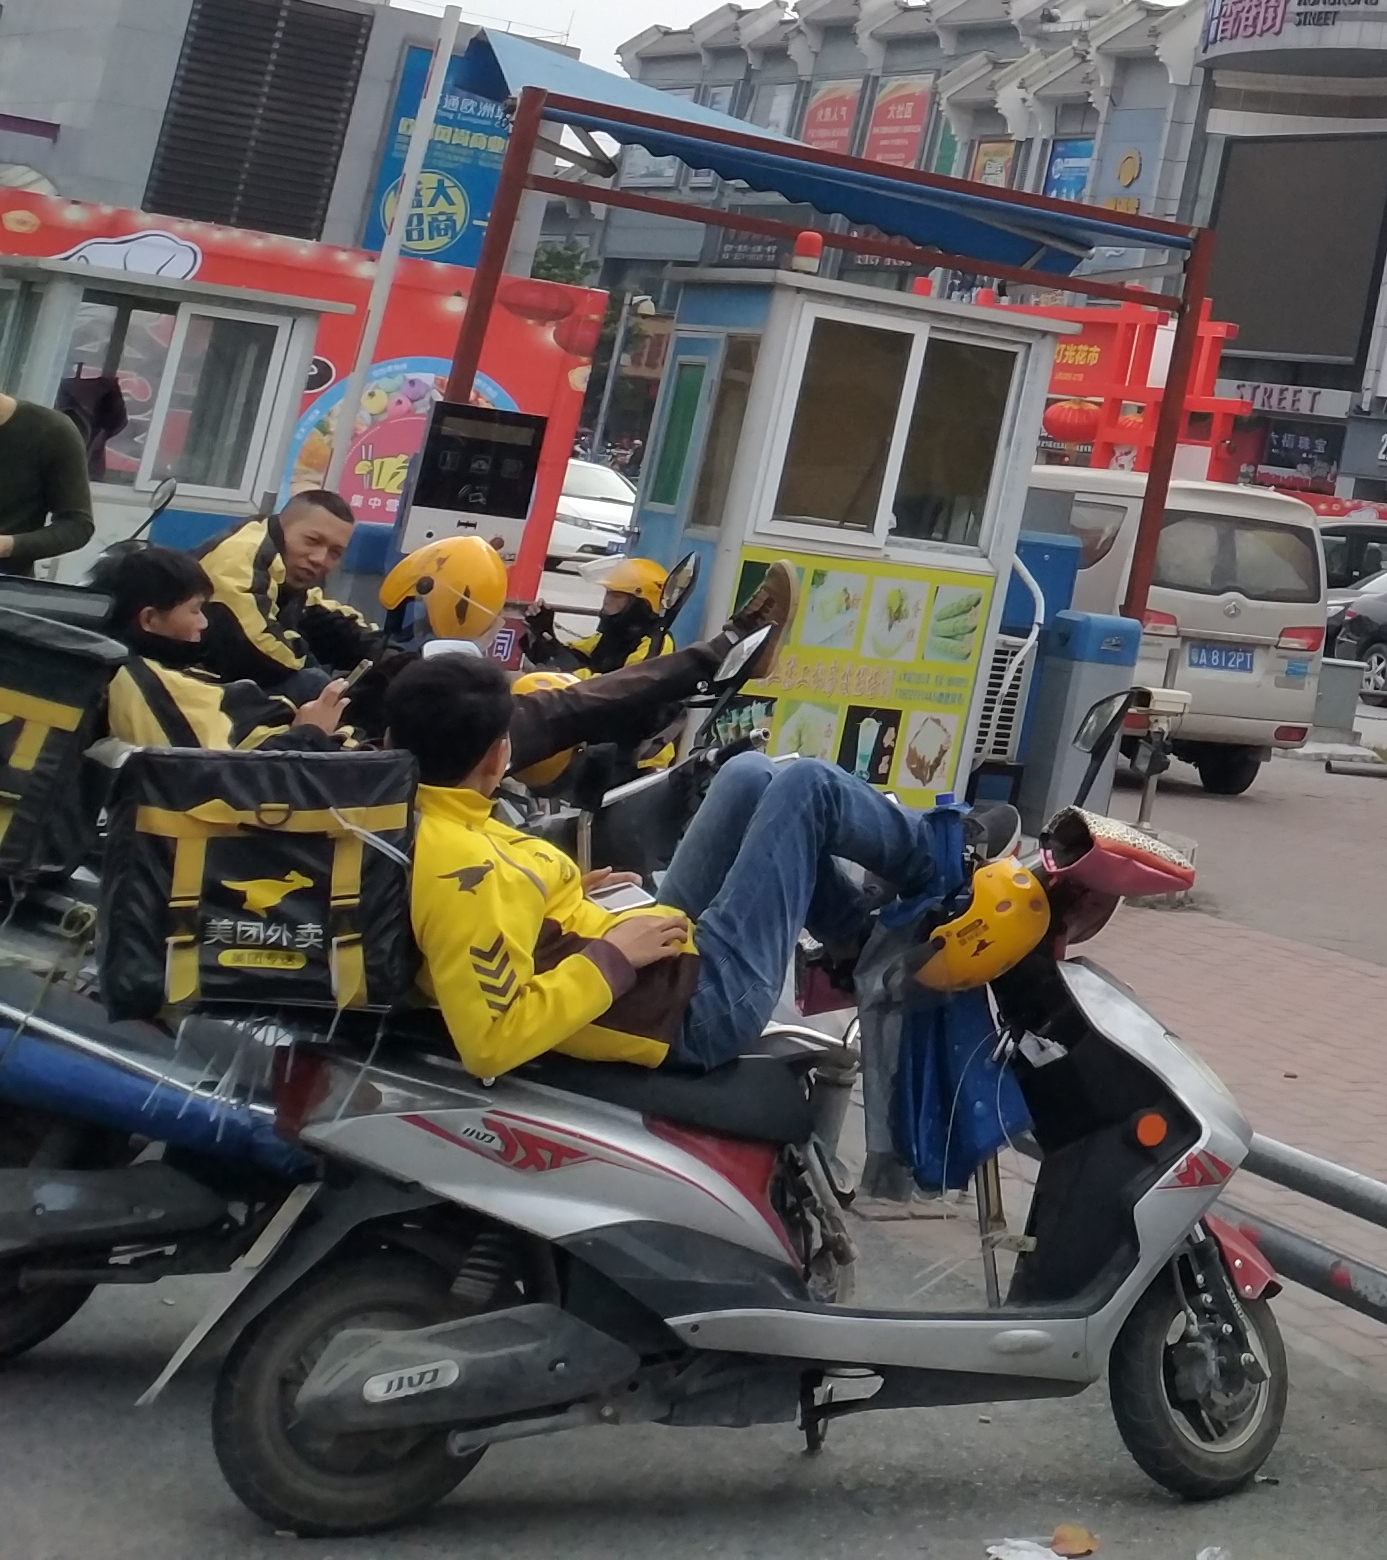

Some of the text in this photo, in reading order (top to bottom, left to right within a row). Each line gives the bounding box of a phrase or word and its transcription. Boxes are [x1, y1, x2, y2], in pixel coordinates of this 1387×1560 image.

[1294, 10, 1341, 26] STREET
[1236, 383, 1322, 413] STREET
[203, 918, 324, 949] 美团外卖
